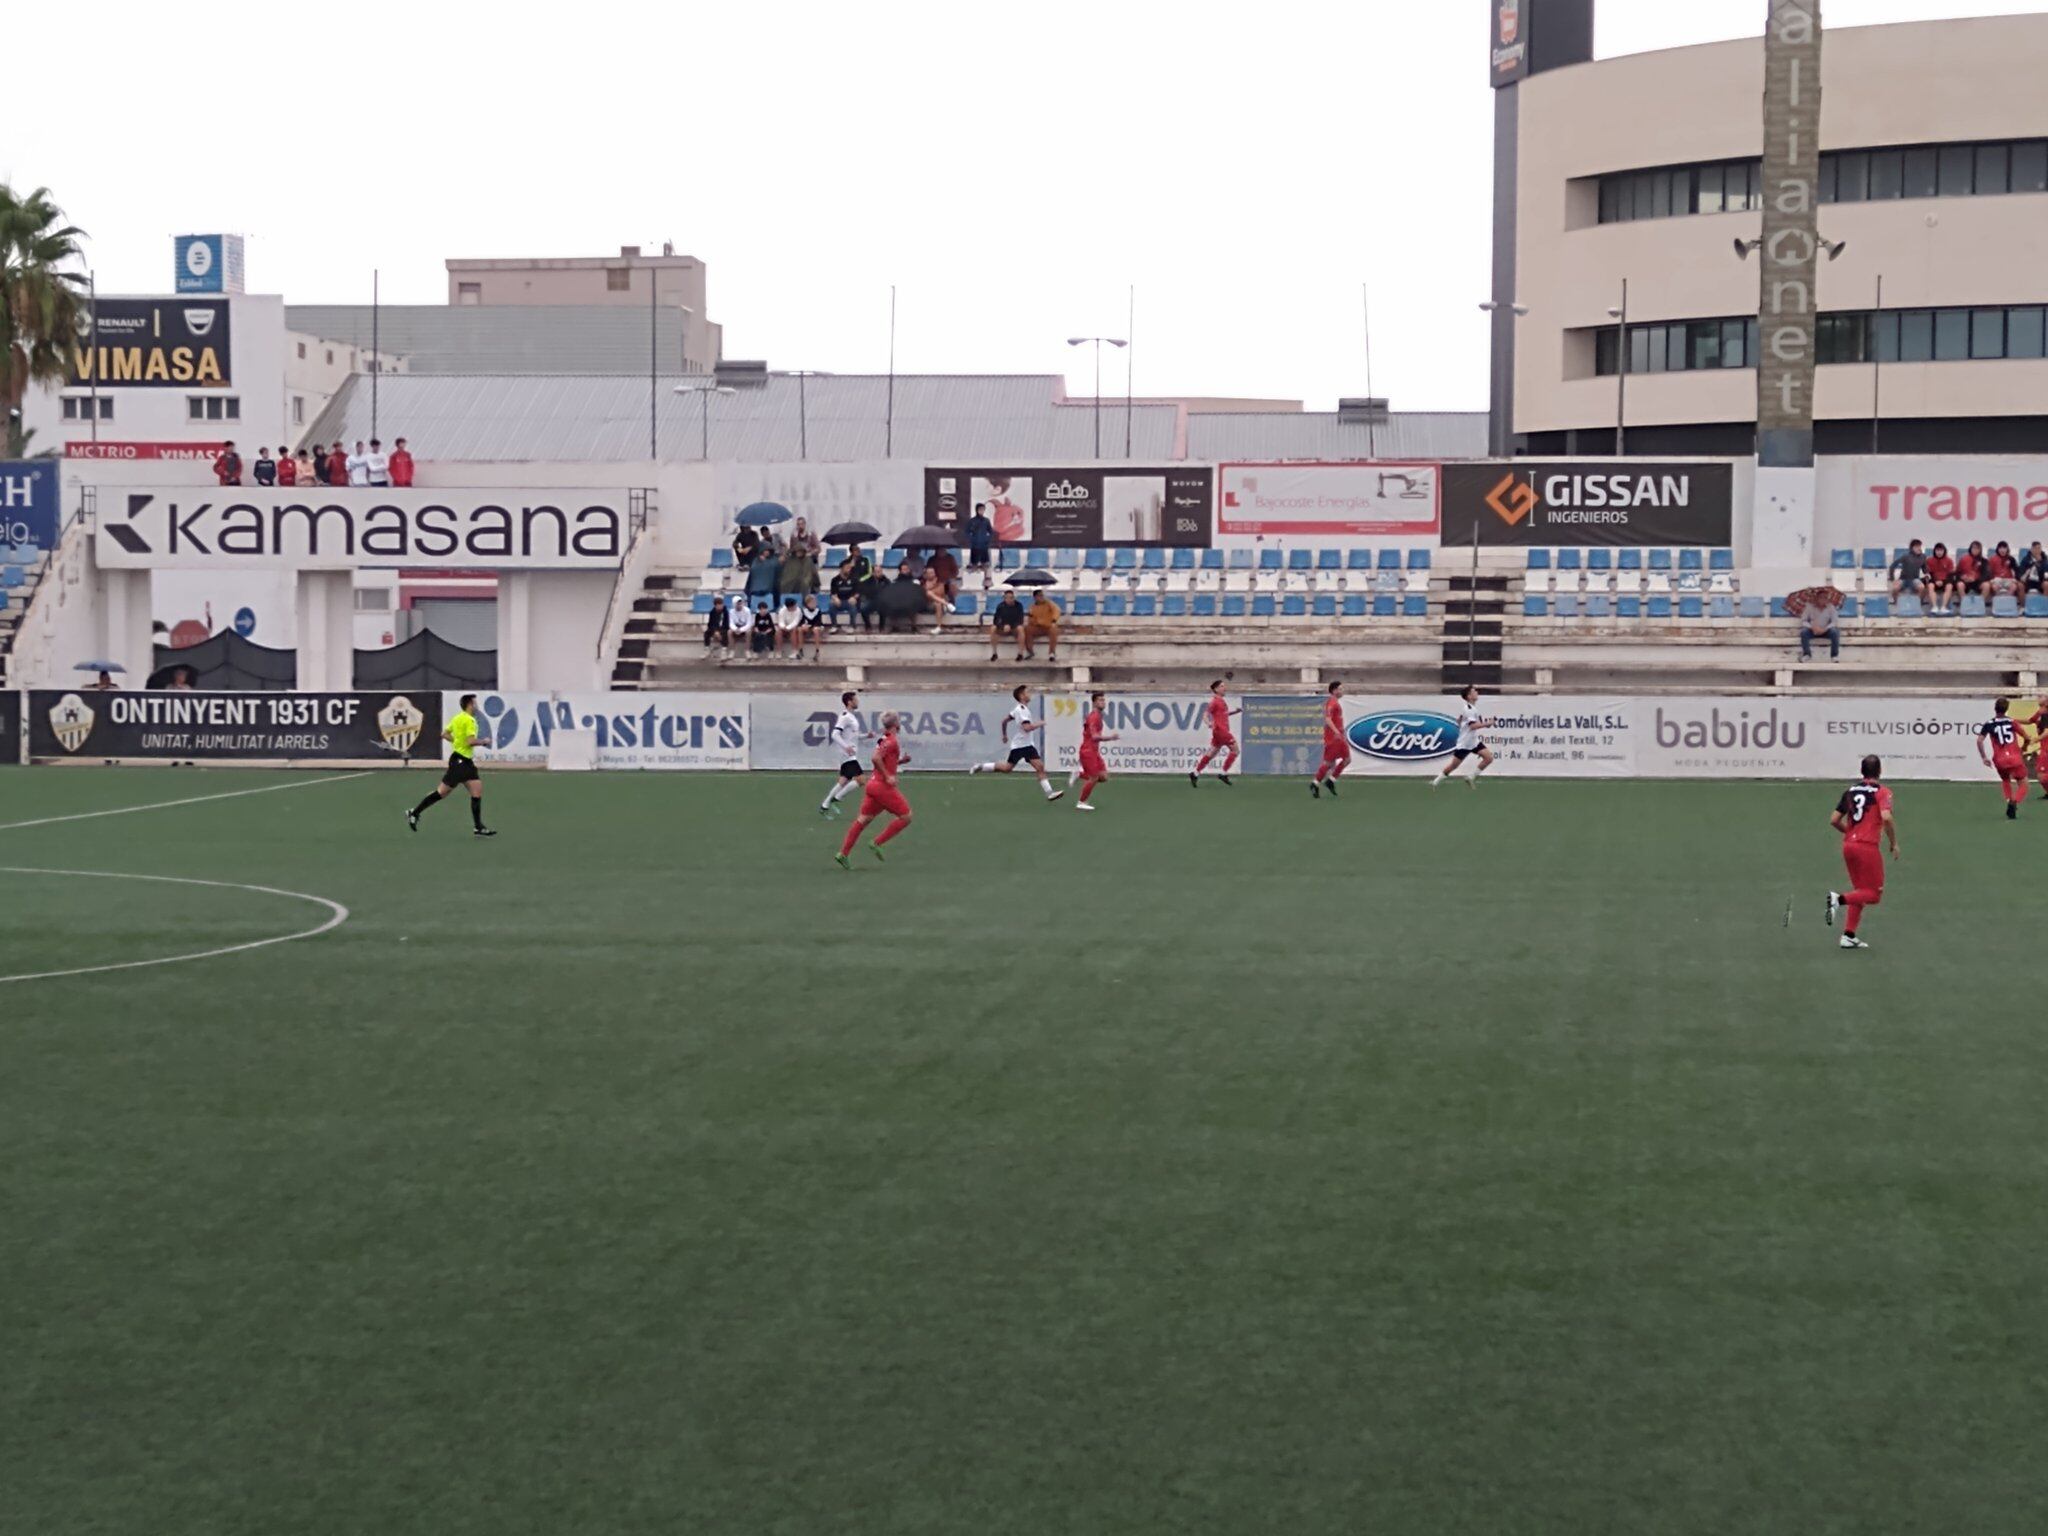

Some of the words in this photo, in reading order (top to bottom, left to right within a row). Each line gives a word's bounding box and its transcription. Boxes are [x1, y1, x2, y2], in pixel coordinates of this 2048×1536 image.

[98, 318, 146, 327] RENAULT
[75, 346, 221, 381] VIMASA
[0, 475, 33, 507] H
[1545, 475, 1689, 507] GISSAN
[1547, 511, 1629, 525] INGENIEROS
[111, 698, 261, 725] ONTINYENT
[267, 699, 320, 725] 1931
[326, 699, 361, 725] CF
[1478, 713, 1555, 729] tomóviles
[1557, 715, 1572, 729] La
[1574, 715, 1603, 731] Vall,
[1605, 715, 1629, 729] S.L.
[1656, 706, 1806, 749] babidu
[141, 734, 192, 749] UNITAT,
[195, 734, 266, 749] HUMILITAT
[273, 735, 329, 750] ARRELS
[1369, 718, 1443, 751] Ford
[1550, 735, 1566, 745] del
[1602, 735, 1614, 745] 12
[1994, 724, 2015, 745] 15
[1059, 746, 1076, 755] NO
[1110, 746, 1168, 756] CUIDAMOS
[1171, 747, 1184, 756] TU
[1571, 750, 1585, 760] 96
[1108, 758, 1122, 768] LA
[1124, 758, 1137, 768] DE
[1140, 759, 1170, 769] TODA
[1171, 759, 1185, 769] TU
[1674, 759, 1710, 768] MODA
[1853, 793, 1866, 822] 3
